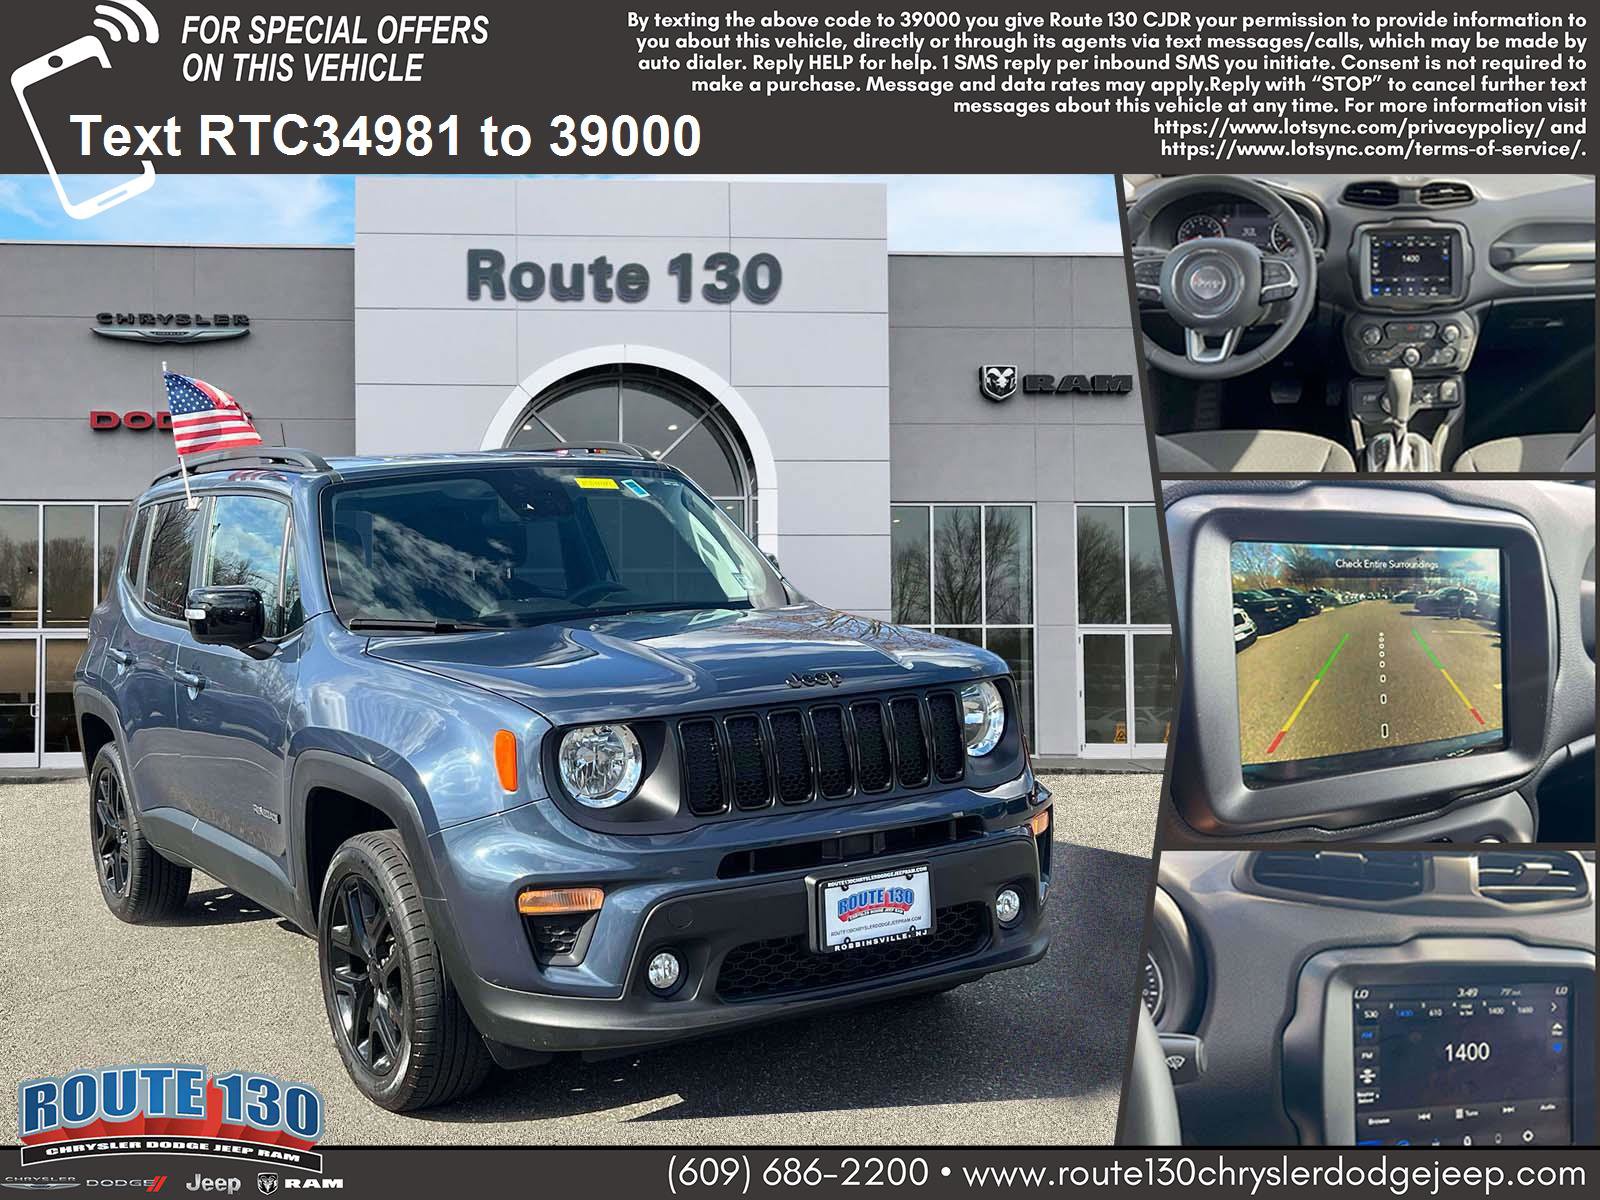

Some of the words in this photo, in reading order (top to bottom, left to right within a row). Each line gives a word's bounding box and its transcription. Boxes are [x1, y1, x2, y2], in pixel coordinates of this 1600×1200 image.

[467, 249, 650, 302] Route
[667, 252, 782, 304] 130
[96, 312, 249, 326] CHRYSLER
[1023, 375, 1133, 393] RAM
[1335, 559, 1362, 568] Check
[1364, 560, 1387, 568] Entire
[1389, 560, 1439, 570] Surroundings
[785, 672, 842, 688] Jeep
[838, 888, 885, 917] ROUTE
[888, 887, 915, 906] 130
[834, 934, 911, 952] ROBBINSVILLE,
[1354, 989, 1369, 999] LO
[1555, 986, 1568, 995] LO
[1445, 1042, 1490, 1062] 1400
